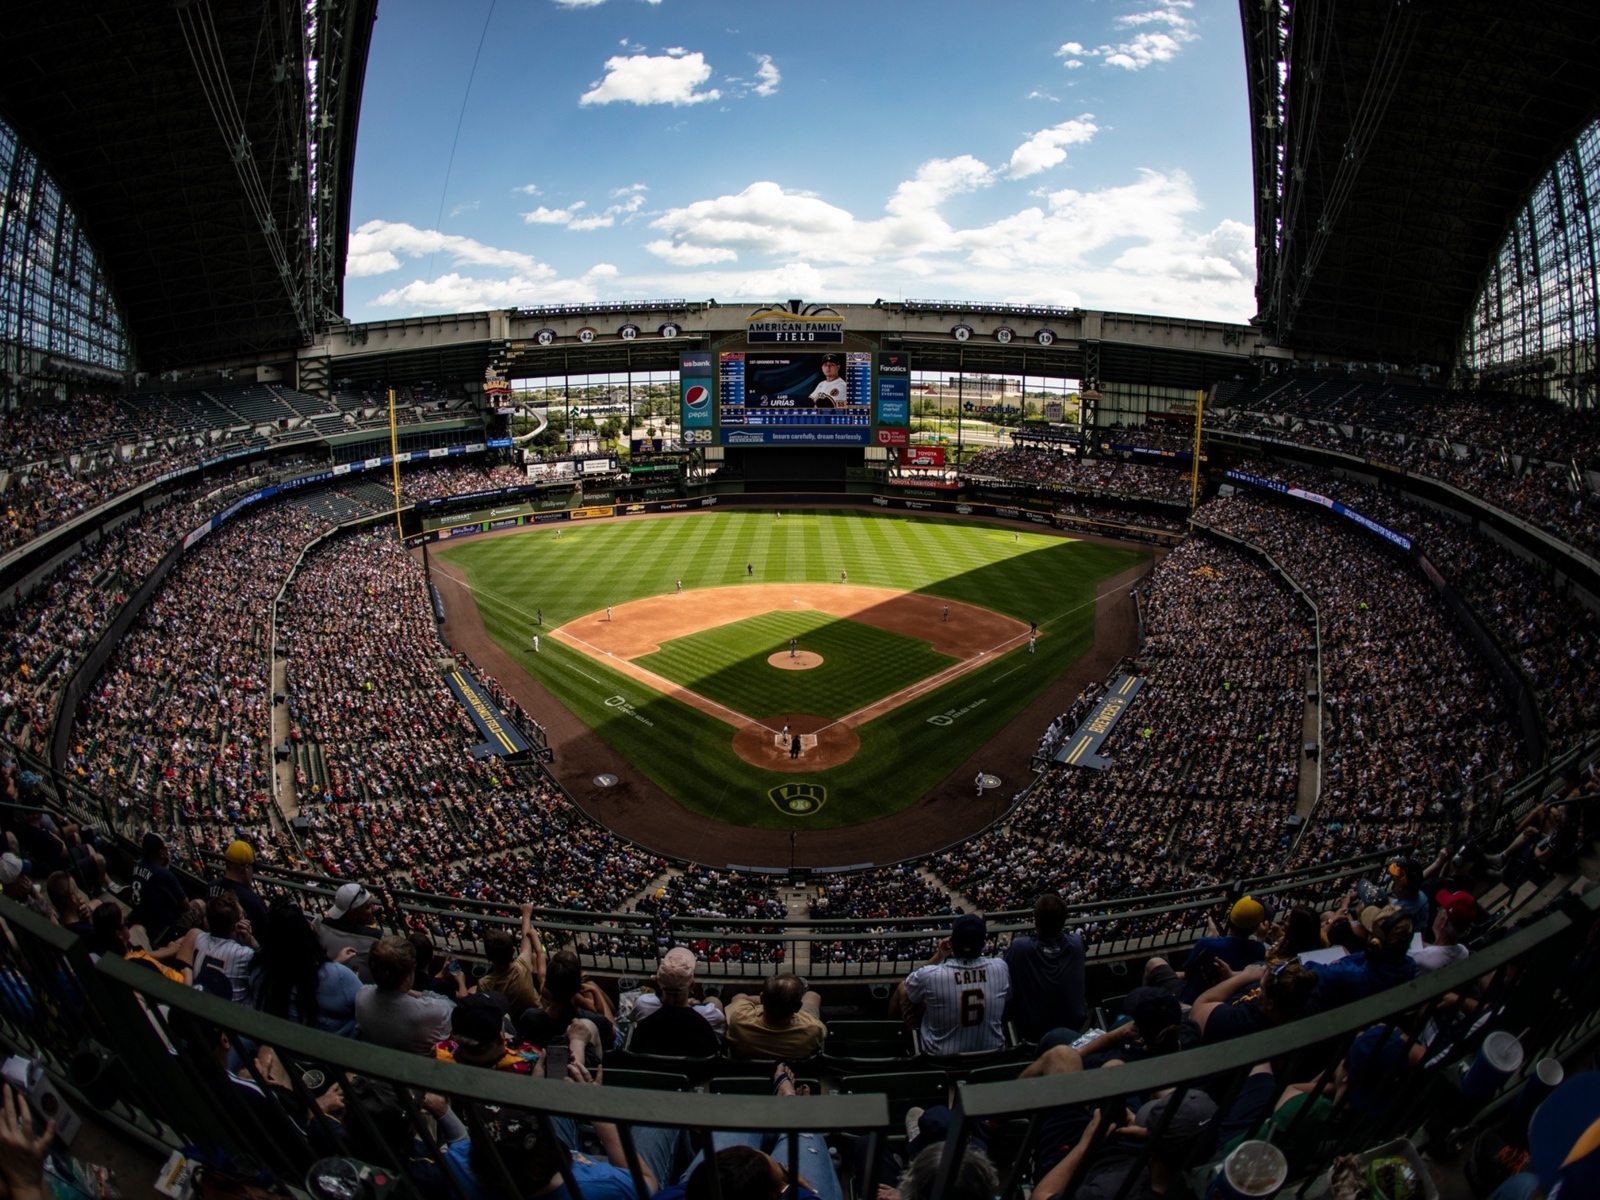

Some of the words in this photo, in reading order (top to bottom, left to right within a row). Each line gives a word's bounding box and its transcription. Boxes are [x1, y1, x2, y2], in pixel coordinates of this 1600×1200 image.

[760, 395, 768, 406] 2
[695, 430, 712, 441] 58
[702, 497, 717, 506] meijer
[1088, 704, 1121, 734] BREWERS
[132, 880, 142, 905] 8
[954, 970, 987, 984] CAIN
[960, 988, 984, 1027] 6
